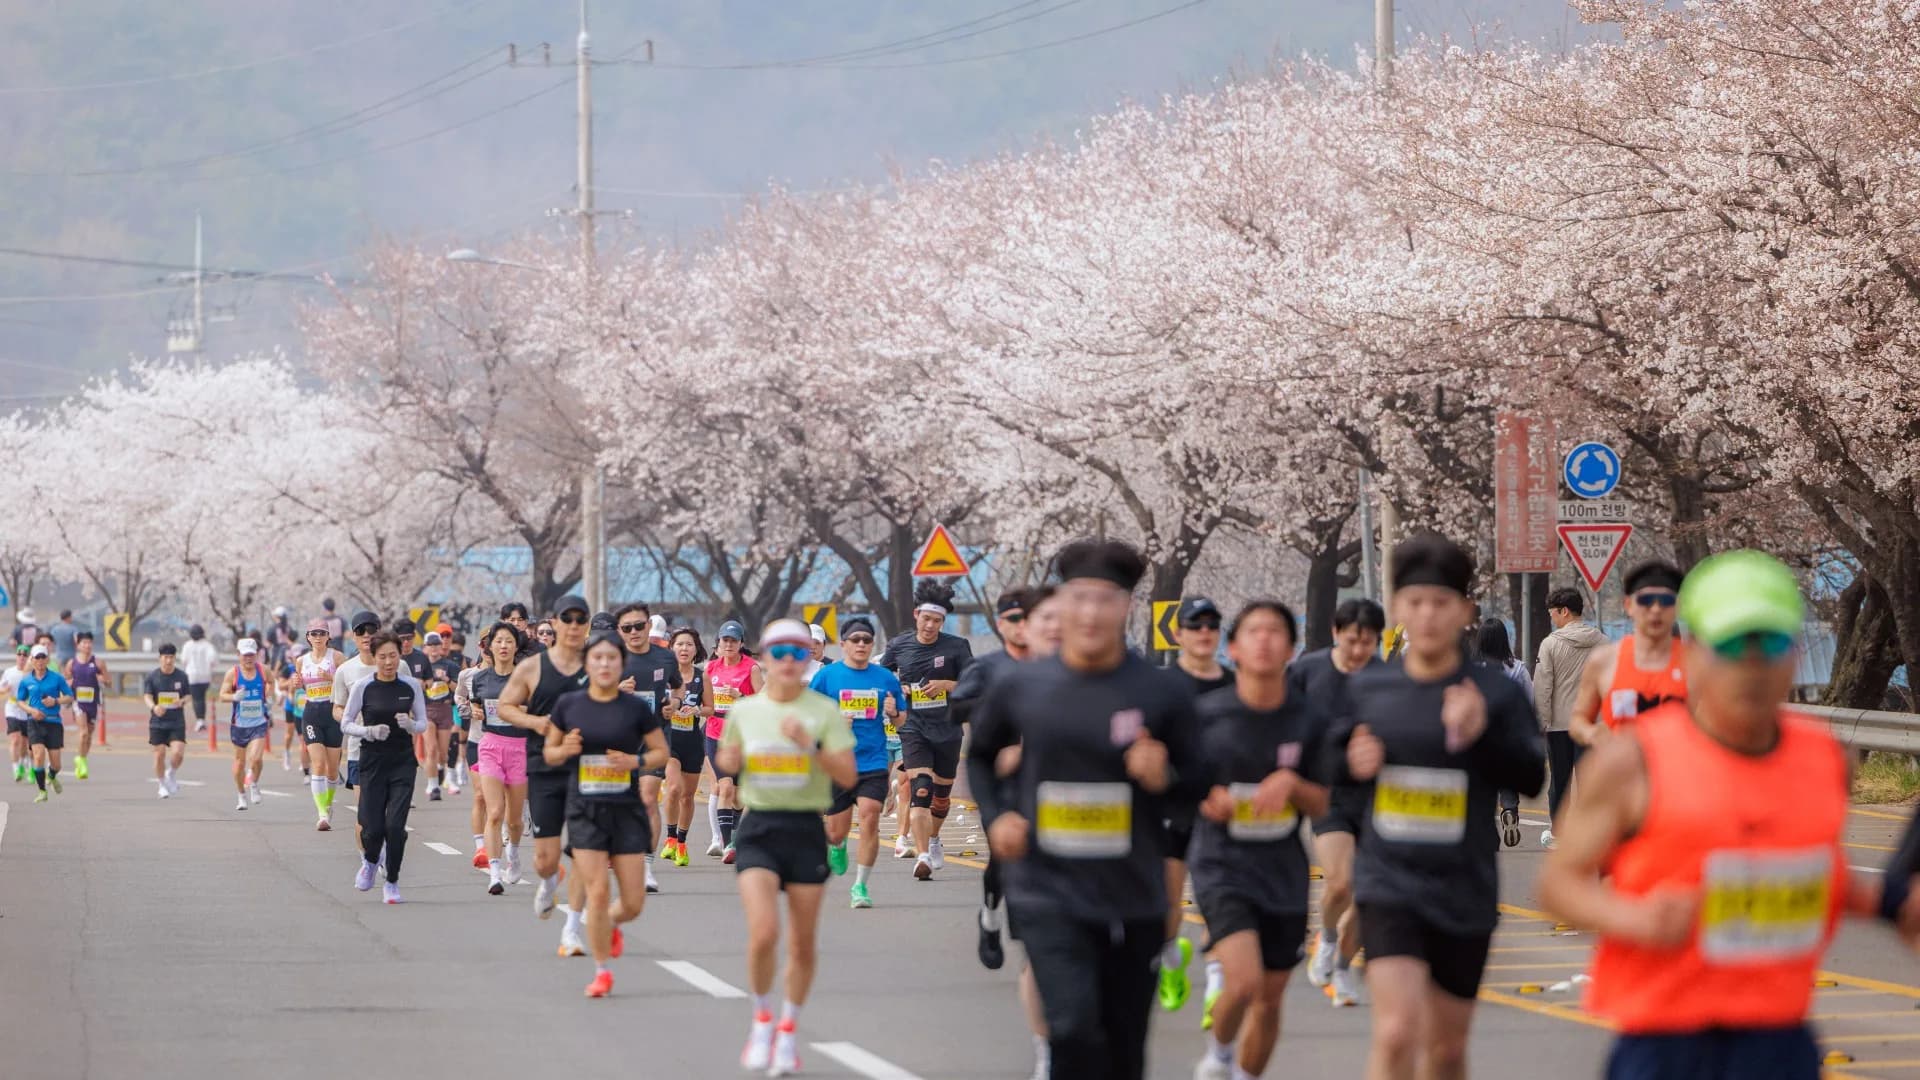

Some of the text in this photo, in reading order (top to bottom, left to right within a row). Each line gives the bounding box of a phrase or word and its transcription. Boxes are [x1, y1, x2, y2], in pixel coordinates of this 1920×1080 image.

[1562, 503, 1626, 517] 100m 전방
[1577, 534, 1613, 547] 천천히
[1582, 548, 1608, 559] SLOW
[844, 697, 875, 707] 12132
